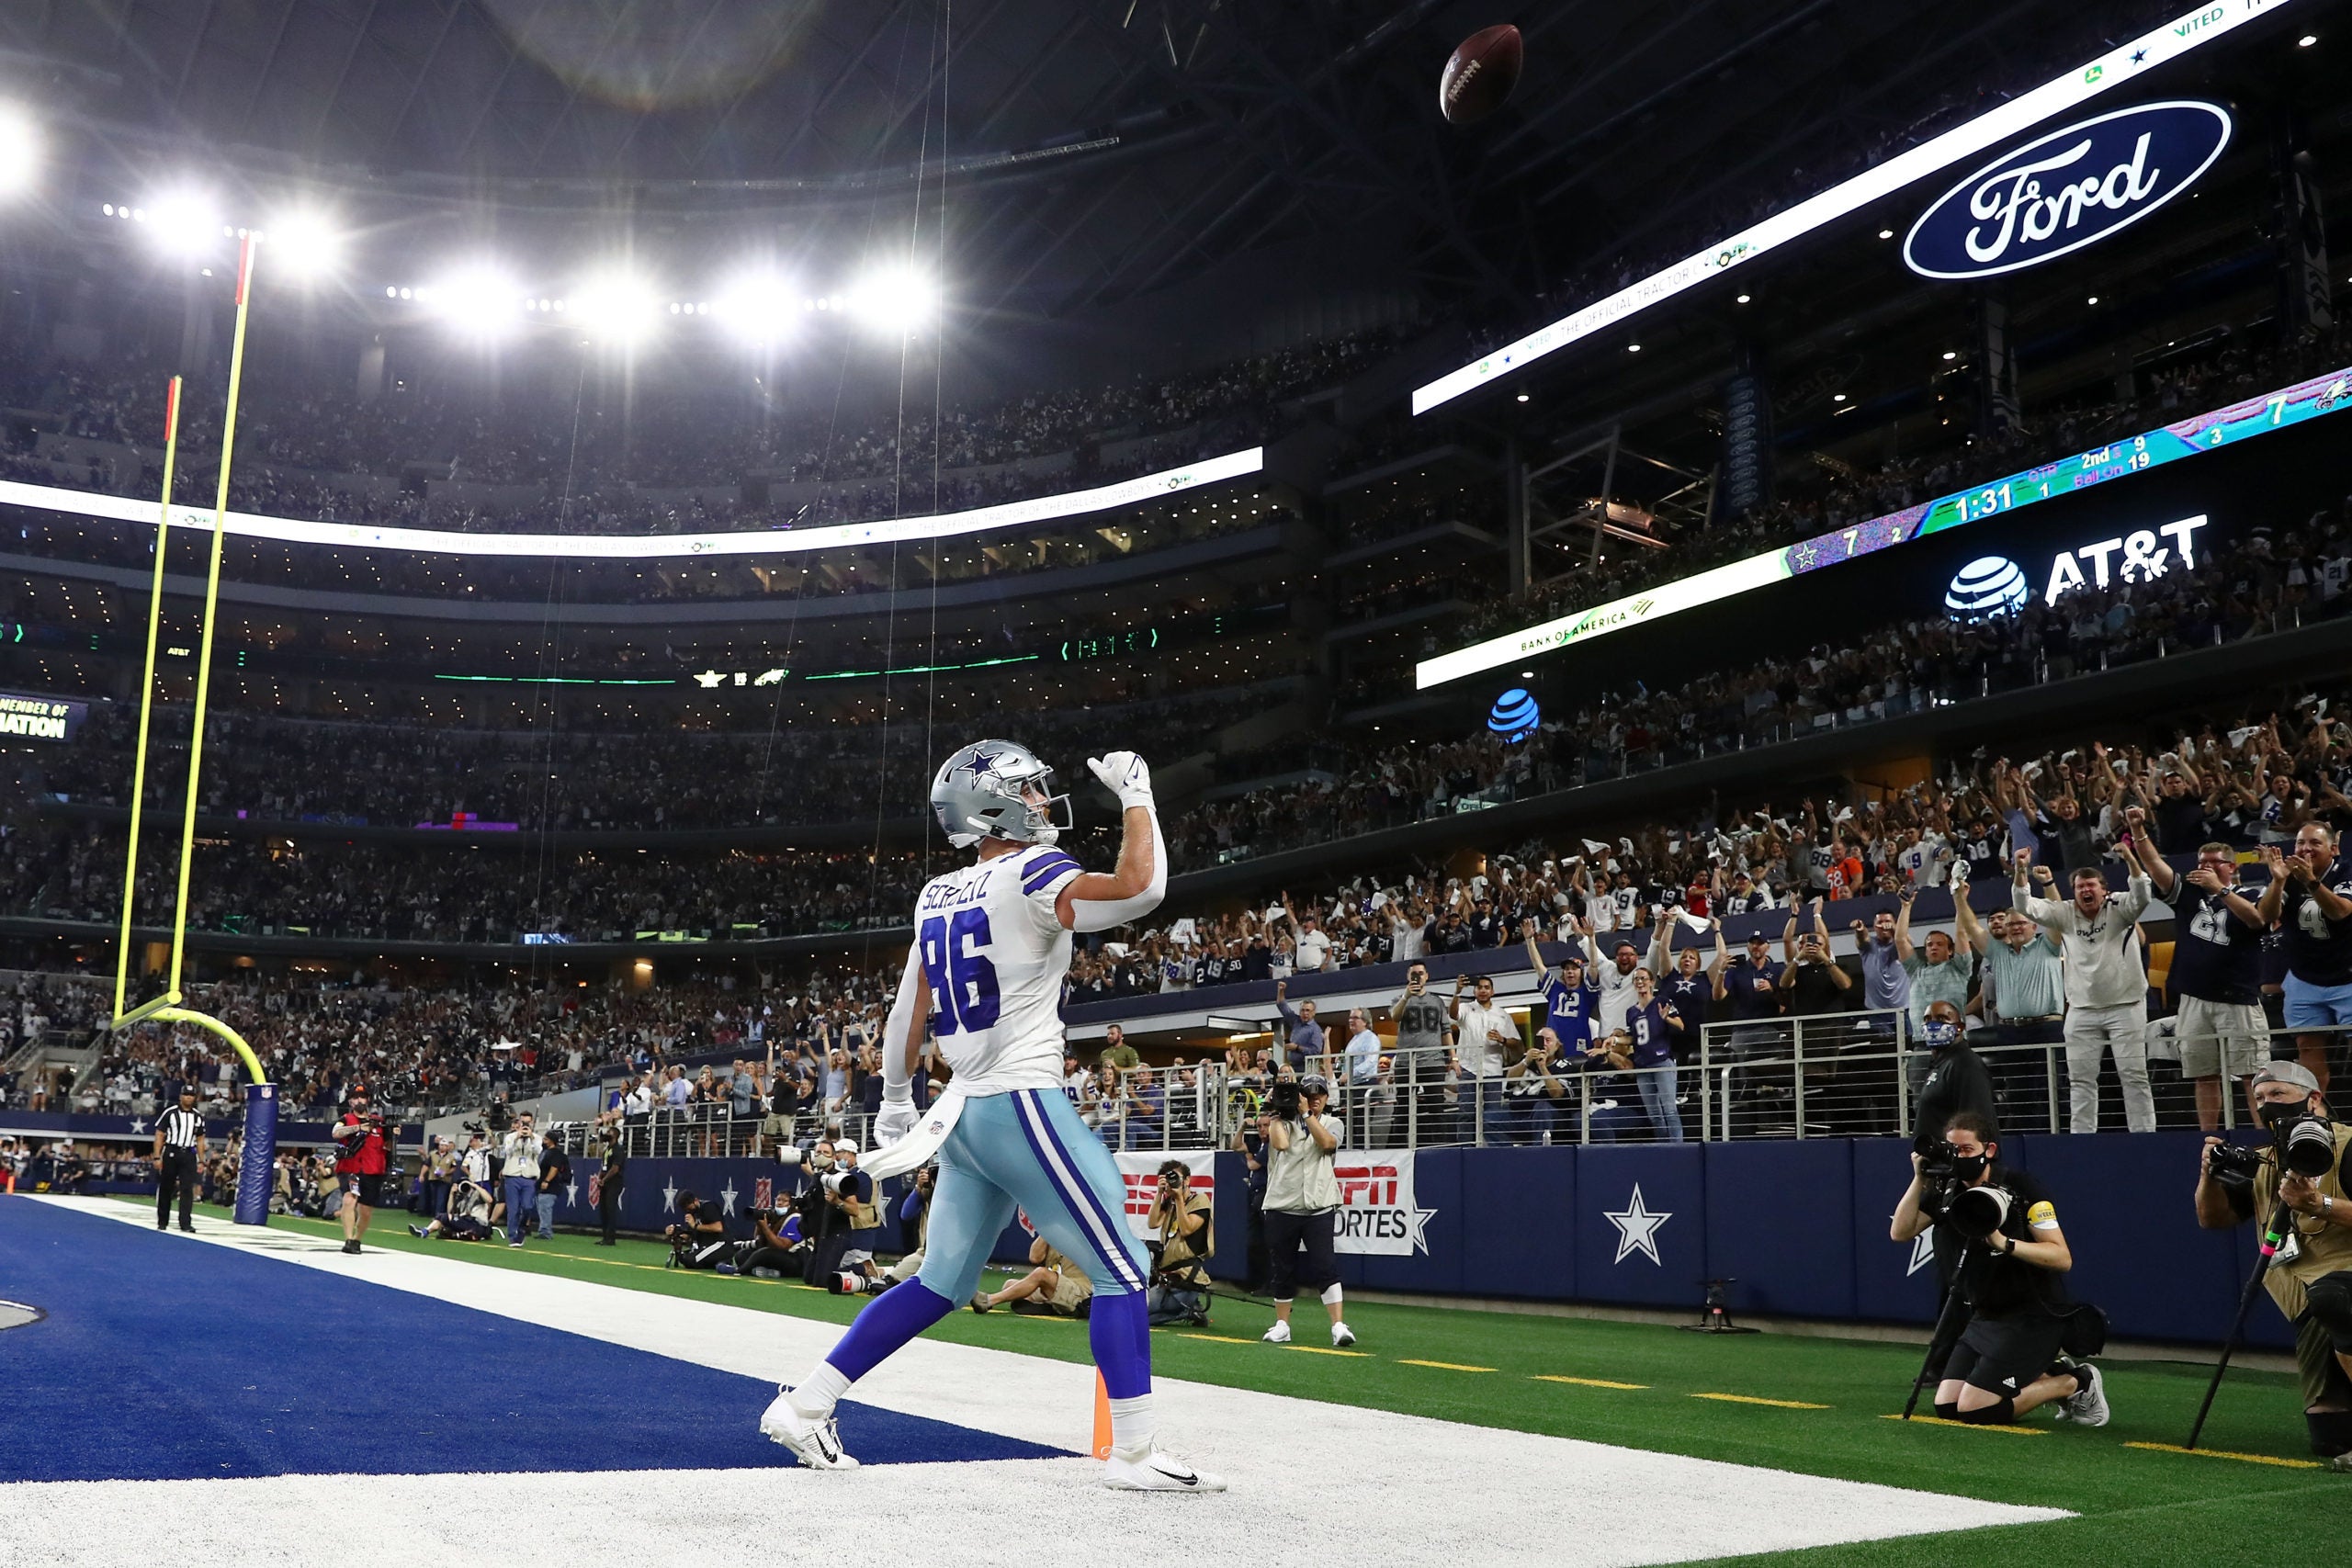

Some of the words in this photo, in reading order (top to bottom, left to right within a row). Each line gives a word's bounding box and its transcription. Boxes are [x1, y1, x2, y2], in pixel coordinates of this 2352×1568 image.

[1964, 132, 2161, 264] Ford
[1561, 321, 1581, 337] THE
[1583, 296, 1634, 328] OFFICIAL
[1636, 267, 1690, 301] TRACTOR
[2267, 393, 2288, 425] 7
[2081, 446, 2110, 469] 2nd
[2133, 435, 2146, 452] 9
[2210, 427, 2222, 445] 3
[2074, 469, 2099, 489] Ball
[2102, 465, 2124, 479] On
[2128, 452, 2151, 471] 19
[940, 516, 980, 531] OFFICIAL
[984, 506, 1026, 524] TRACTOR
[1065, 494, 1103, 510] DALLAS
[1105, 482, 1152, 503] COWBOYS
[1955, 483, 2012, 522] 1:31
[2039, 482, 2050, 498] 1
[1843, 529, 1859, 555] 7
[1891, 527, 1902, 543] 2
[2044, 513, 2208, 608] AT&T
[1521, 635, 1551, 651] BANK
[1555, 628, 1569, 641] OF
[1572, 612, 1627, 637] AMERICA
[51, 704, 70, 717] OF
[2189, 898, 2231, 946] 21
[2298, 897, 2331, 941] 4
[919, 906, 1001, 1037] 86
[1166, 964, 1180, 979] 98
[1402, 1005, 1441, 1033] 88
[1553, 992, 1580, 1018] 12
[1635, 1018, 1650, 1046] 9
[1121, 1174, 1215, 1215] ESN
[1333, 1166, 1397, 1205] PN
[1333, 1209, 1407, 1239] ORTES
